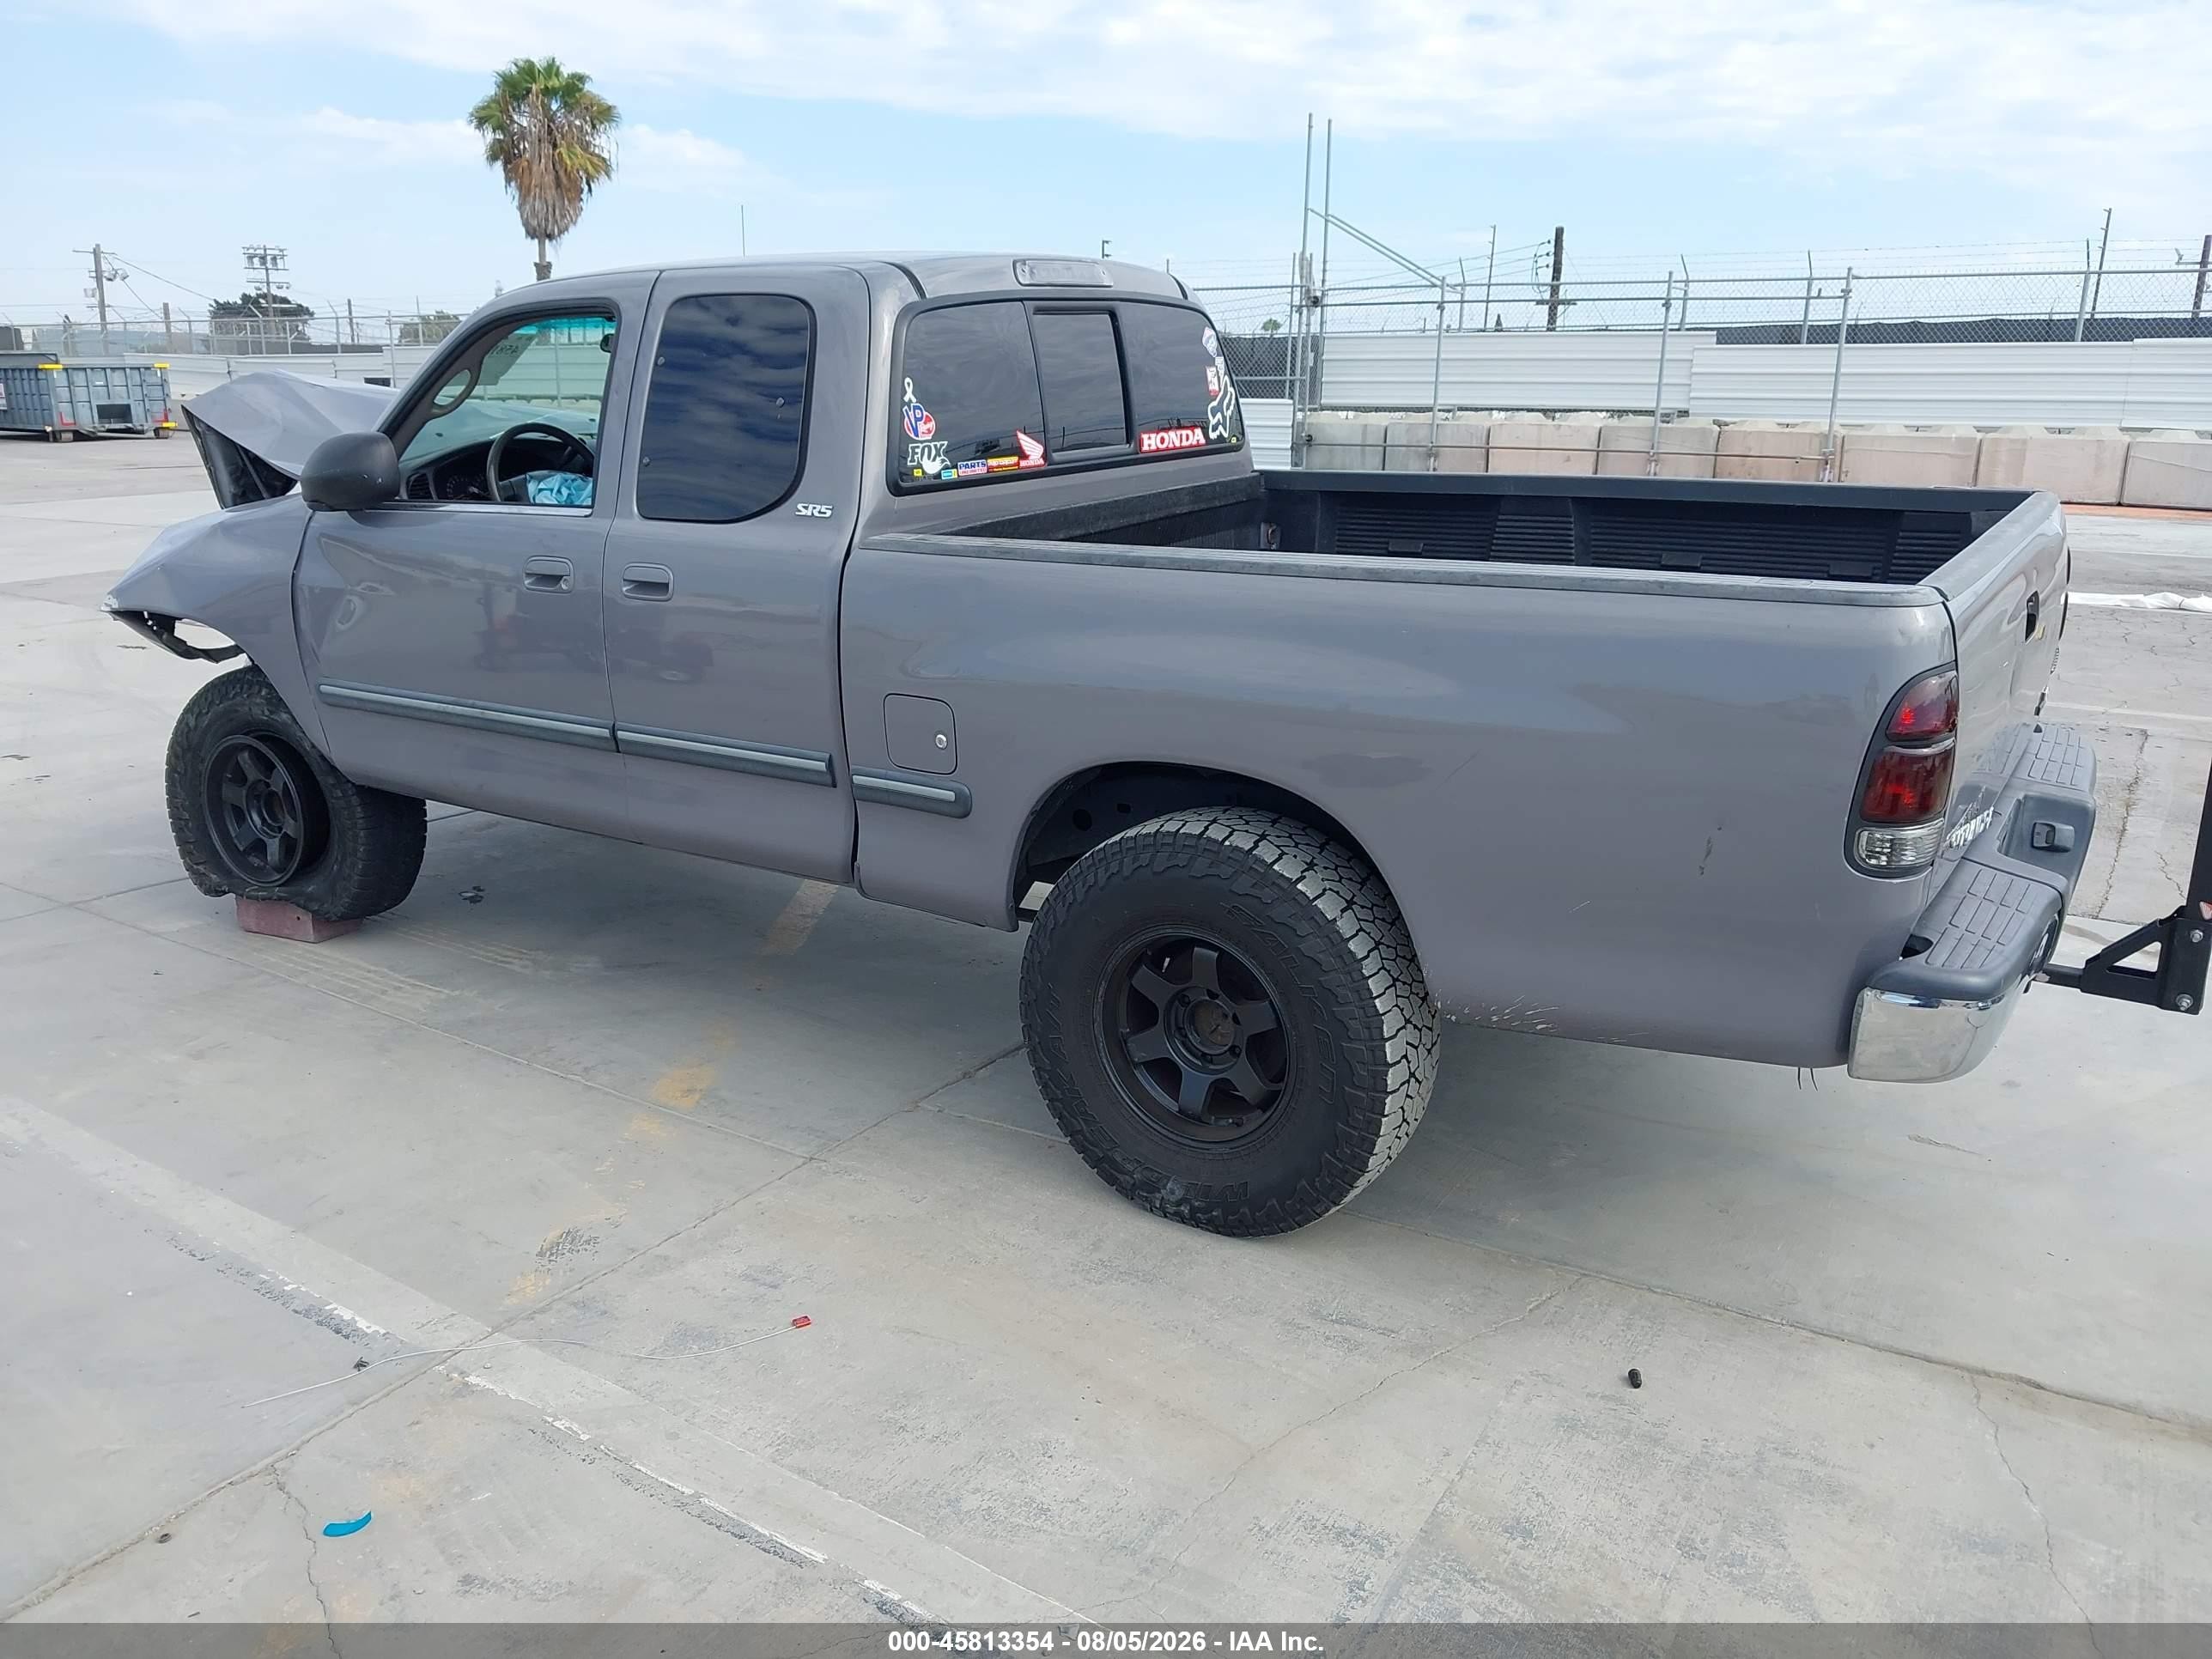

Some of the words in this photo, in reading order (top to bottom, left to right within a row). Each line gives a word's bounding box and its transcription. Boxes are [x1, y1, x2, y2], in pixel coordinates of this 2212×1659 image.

[1140, 428, 1206, 452] HONDA
[907, 441, 948, 466] FOX
[958, 460, 987, 471] PARTS
[1019, 458, 1045, 467] HONDA
[795, 503, 833, 518] SR5
